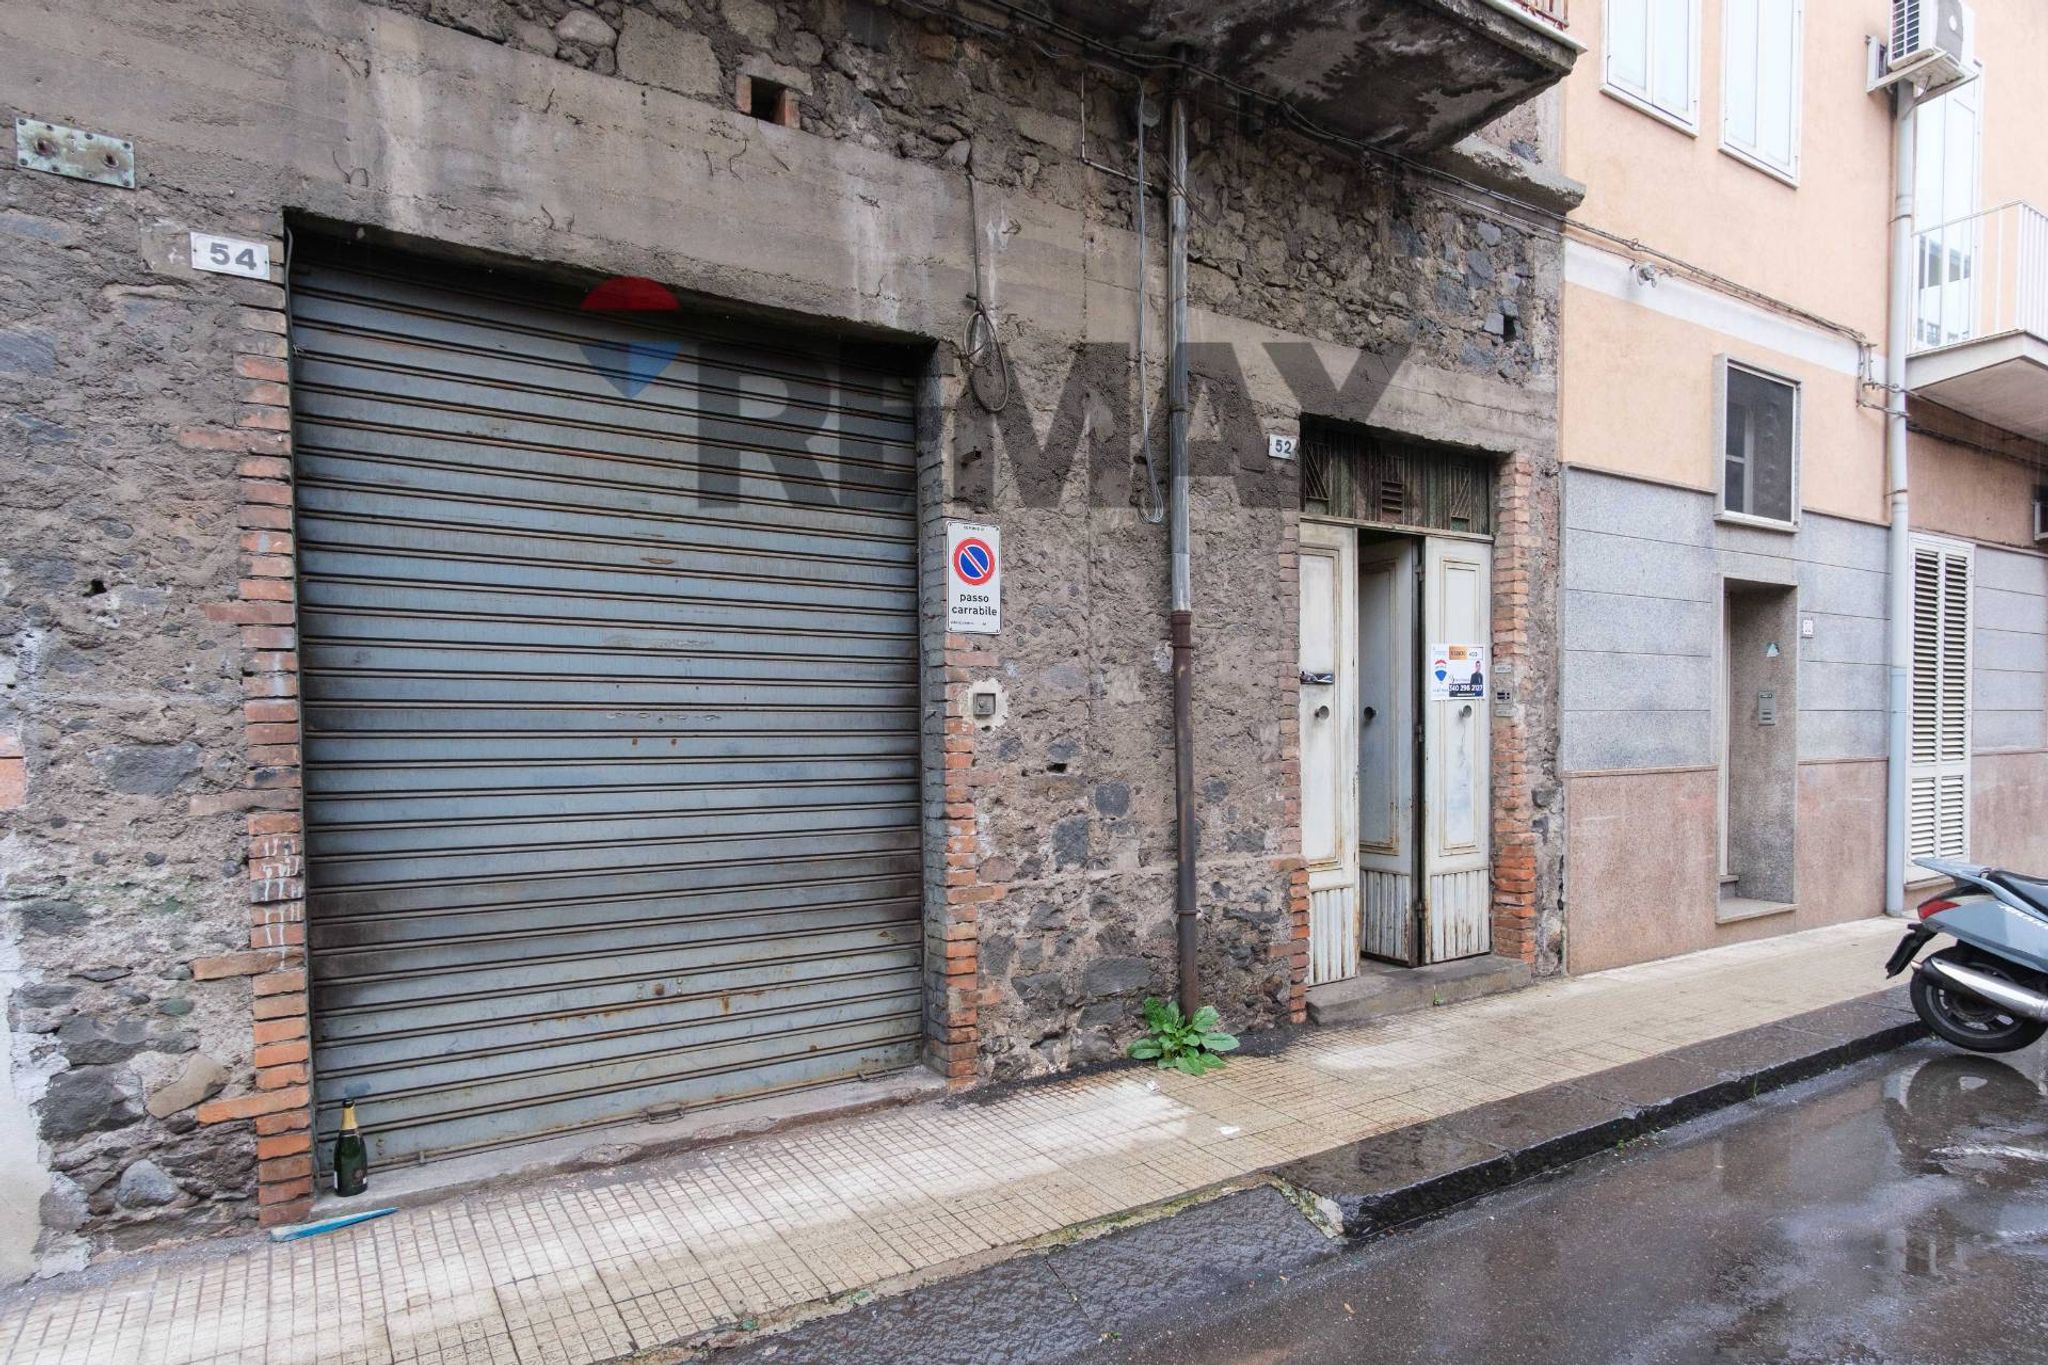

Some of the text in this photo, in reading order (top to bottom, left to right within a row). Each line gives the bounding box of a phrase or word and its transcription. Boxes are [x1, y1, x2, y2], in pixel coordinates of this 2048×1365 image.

[210, 242, 257, 270] 54
[1275, 439, 1292, 454] 52
[959, 593, 989, 603] passo
[951, 605, 998, 616] carrabile
